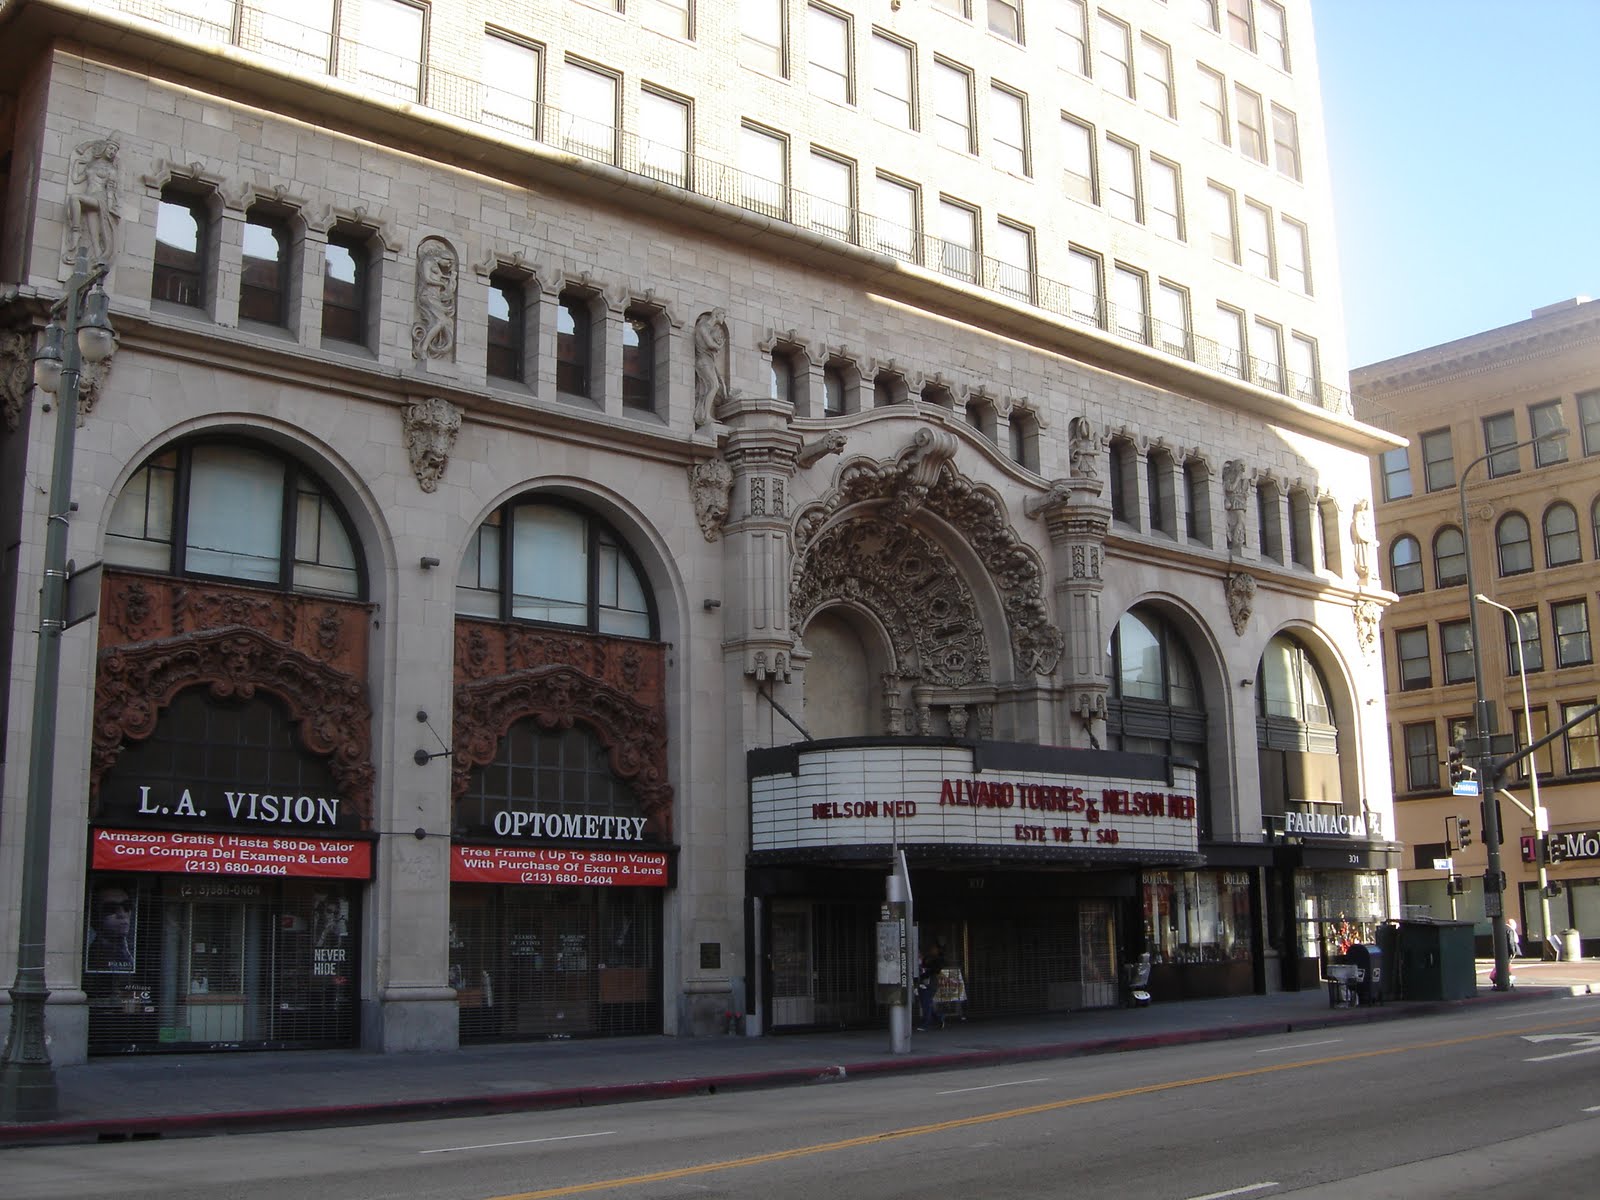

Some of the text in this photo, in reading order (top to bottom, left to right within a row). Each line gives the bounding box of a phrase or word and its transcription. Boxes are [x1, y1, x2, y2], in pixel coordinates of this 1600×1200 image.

[138, 786, 340, 825] L.A. VISION
[812, 800, 917, 819] NELSON NED
[939, 779, 1196, 823] ALVARO TORRES & NELSON NED
[494, 811, 648, 841] OPTOMETRY
[1284, 811, 1367, 836] FARMACIA
[99, 830, 166, 843] Armazon
[171, 833, 215, 845] Gratis
[228, 836, 269, 849] Hasta
[273, 839, 297, 850] $80
[299, 842, 316, 851] De
[320, 842, 355, 852] Valor
[1014, 824, 1119, 844] ESTE VIE Y SAB
[114, 845, 349, 864] Con Compra Del Examen & Lente
[460, 847, 491, 856] Free
[494, 848, 536, 858] Frame
[548, 850, 566, 861] Up
[570, 851, 585, 860] To
[589, 853, 612, 863] $80
[615, 854, 626, 863] In
[629, 854, 666, 866] Value)
[185, 860, 287, 875] (213) 680-0404
[463, 858, 663, 875] With Purchase Of Exam & Lens
[521, 872, 613, 885] (213) 680-0404
[1223, 872, 1250, 886] DOLLAR
[314, 948, 346, 962] NEVER
[314, 963, 337, 976] HIDE
